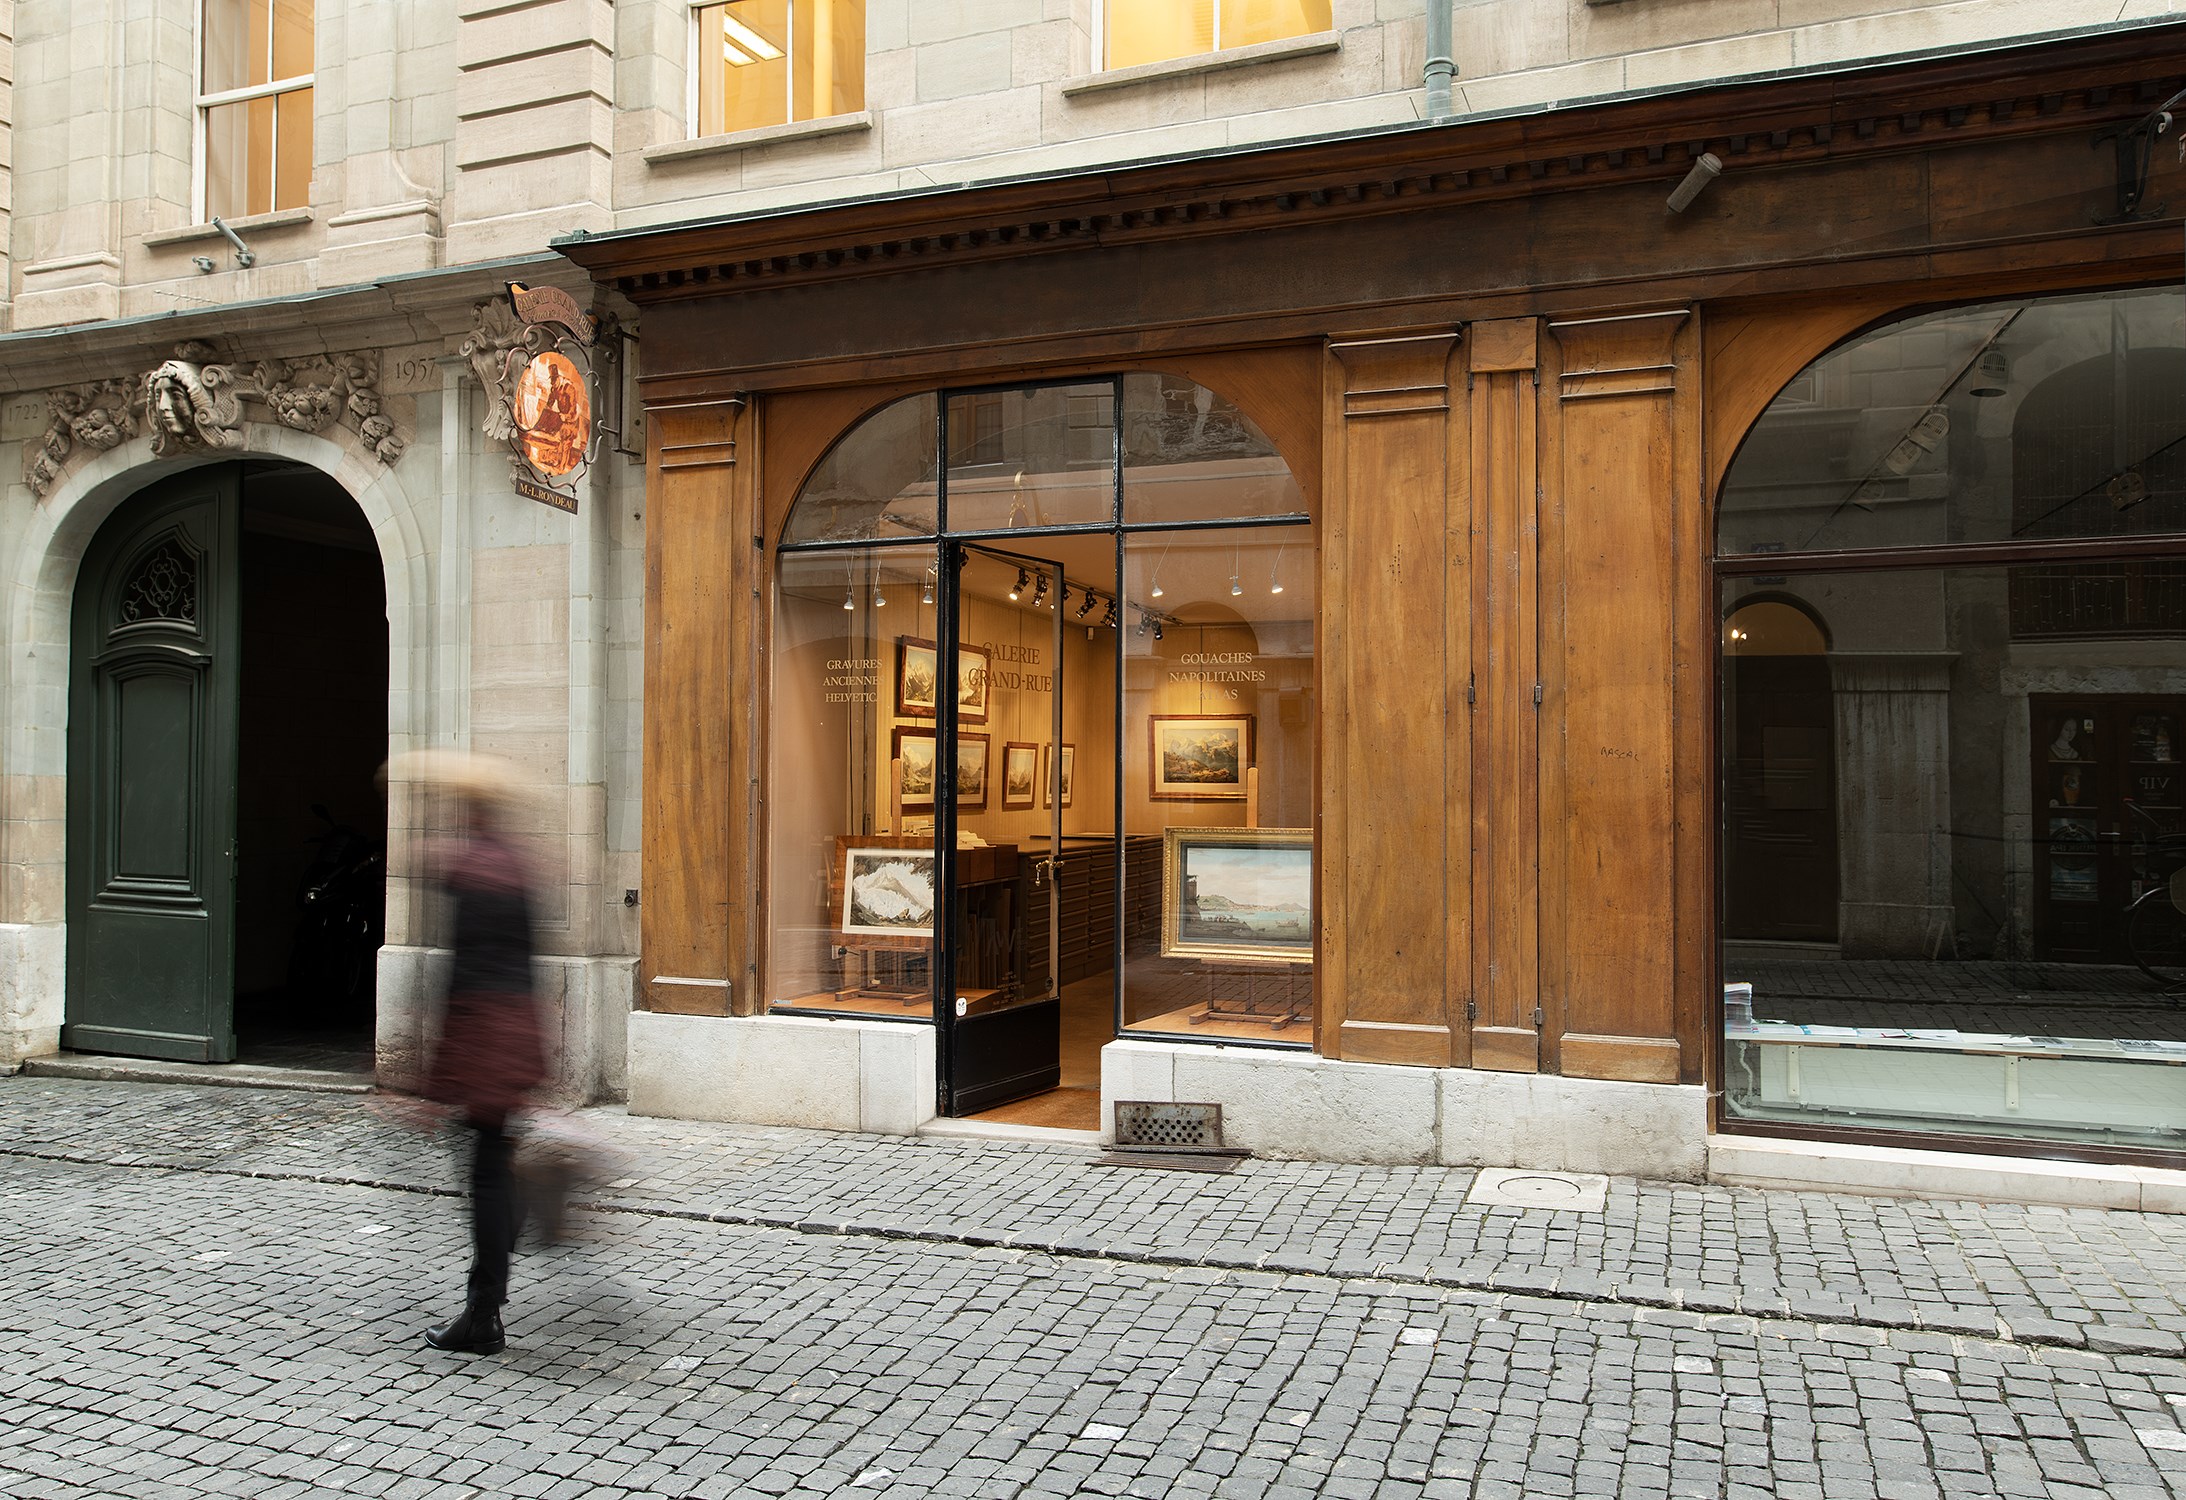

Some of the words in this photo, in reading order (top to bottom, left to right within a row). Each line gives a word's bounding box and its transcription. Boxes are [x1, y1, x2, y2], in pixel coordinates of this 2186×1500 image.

[516, 289, 549, 313] GALERIE
[551, 290, 595, 338] GRAND-RUE
[396, 357, 436, 386] 1957
[9, 403, 39, 422] 1722
[982, 642, 1040, 665] GALERIE
[1181, 652, 1253, 665] GOUACHES
[826, 659, 883, 670] GRAVURES
[968, 668, 1053, 692] GRAND-RUE
[1169, 670, 1266, 683] NAPOLITAINES
[825, 692, 881, 703] HELVETIC
